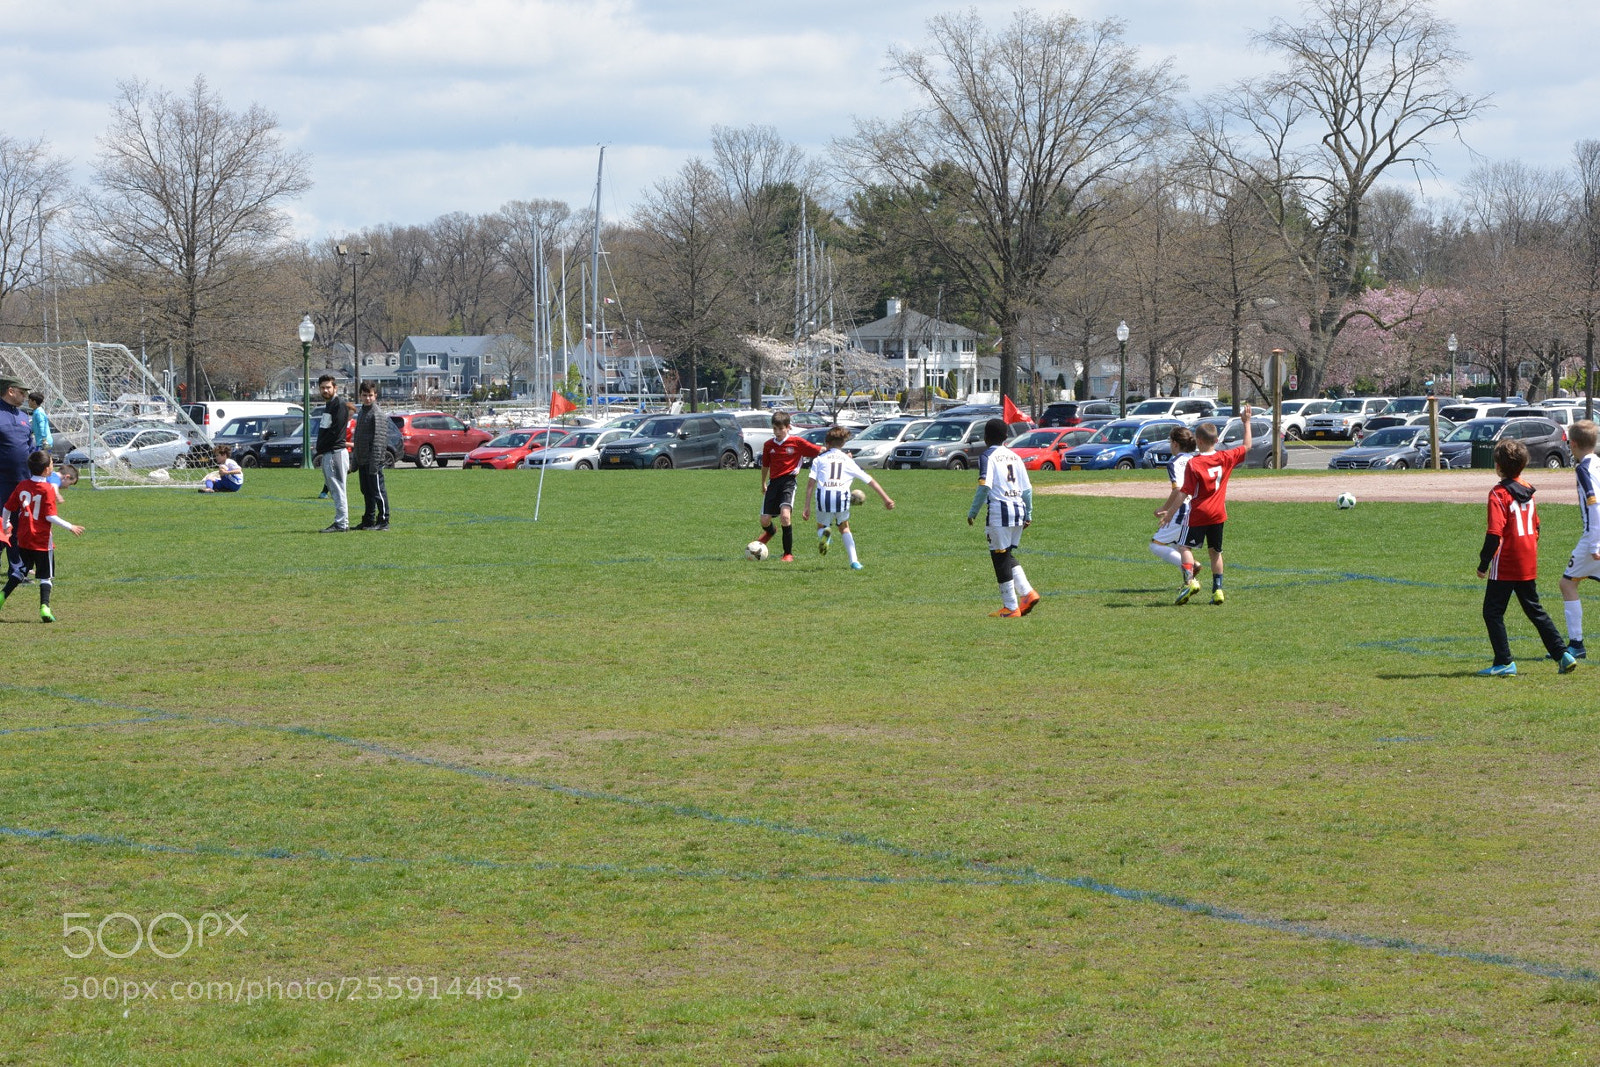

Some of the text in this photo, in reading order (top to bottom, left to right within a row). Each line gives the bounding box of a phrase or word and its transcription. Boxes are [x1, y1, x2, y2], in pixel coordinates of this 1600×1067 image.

[830, 462, 842, 480] 11
[1007, 464, 1016, 483] 4
[1207, 465, 1223, 492] 7
[1509, 498, 1535, 537] 17
